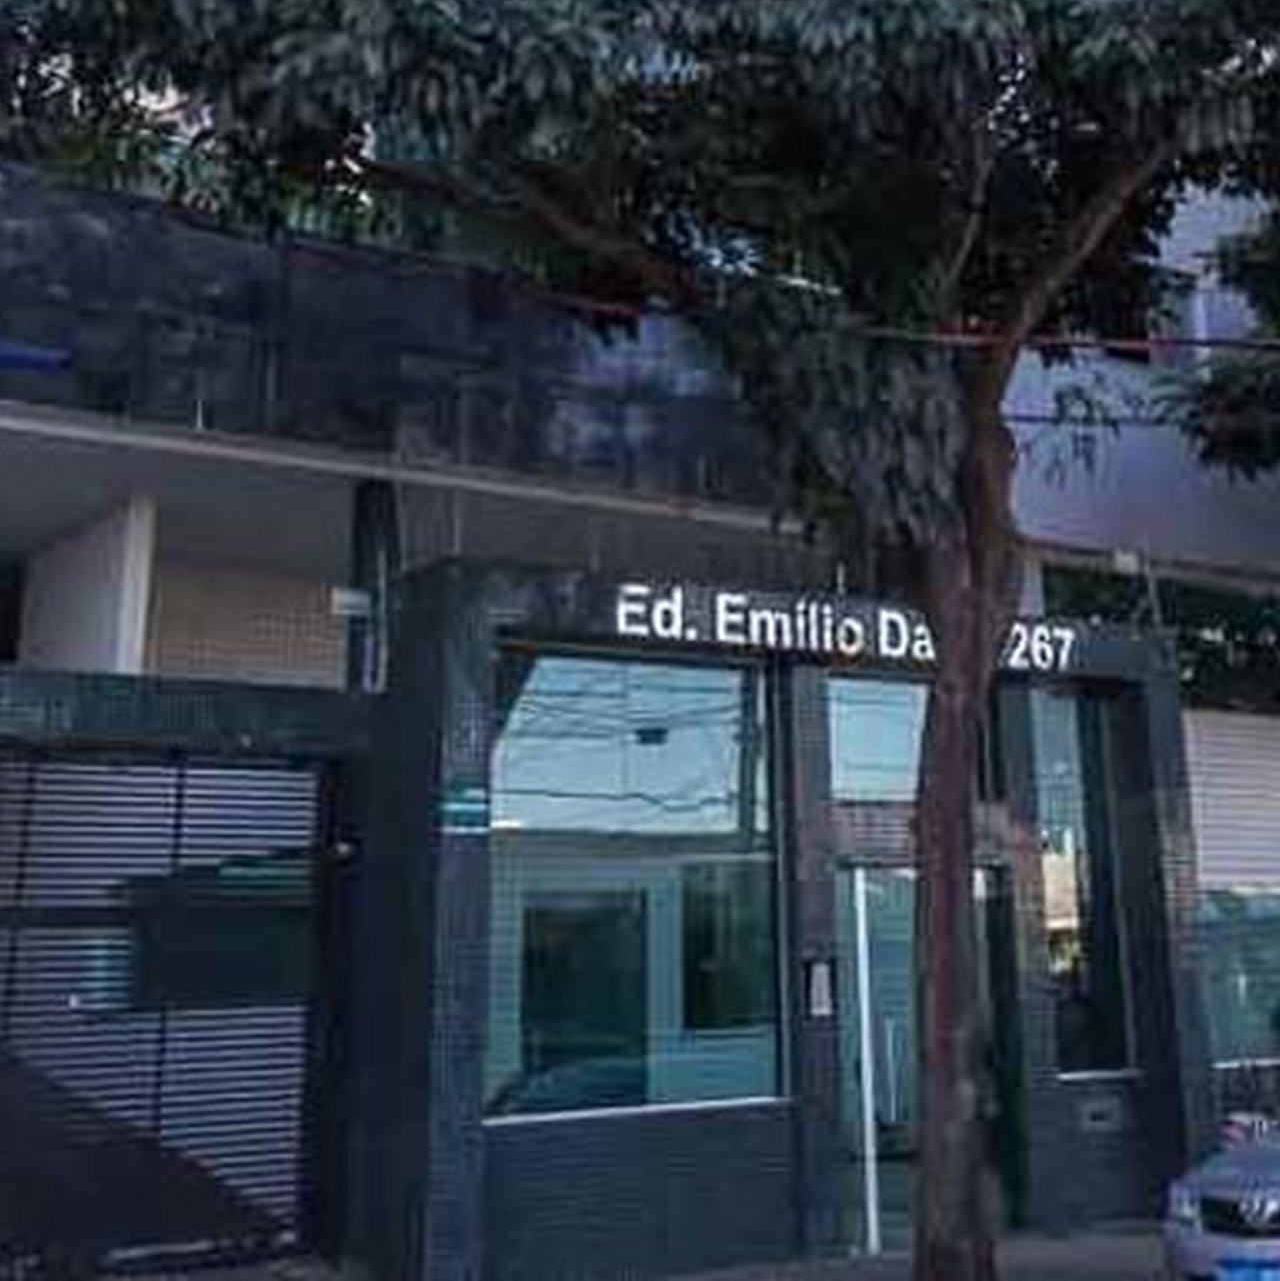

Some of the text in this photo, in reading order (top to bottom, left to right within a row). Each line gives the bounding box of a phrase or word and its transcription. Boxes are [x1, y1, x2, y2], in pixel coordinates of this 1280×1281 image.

[617, 583, 697, 641] Ed.
[878, 608, 937, 660] Da
[1008, 622, 1076, 670] 267
